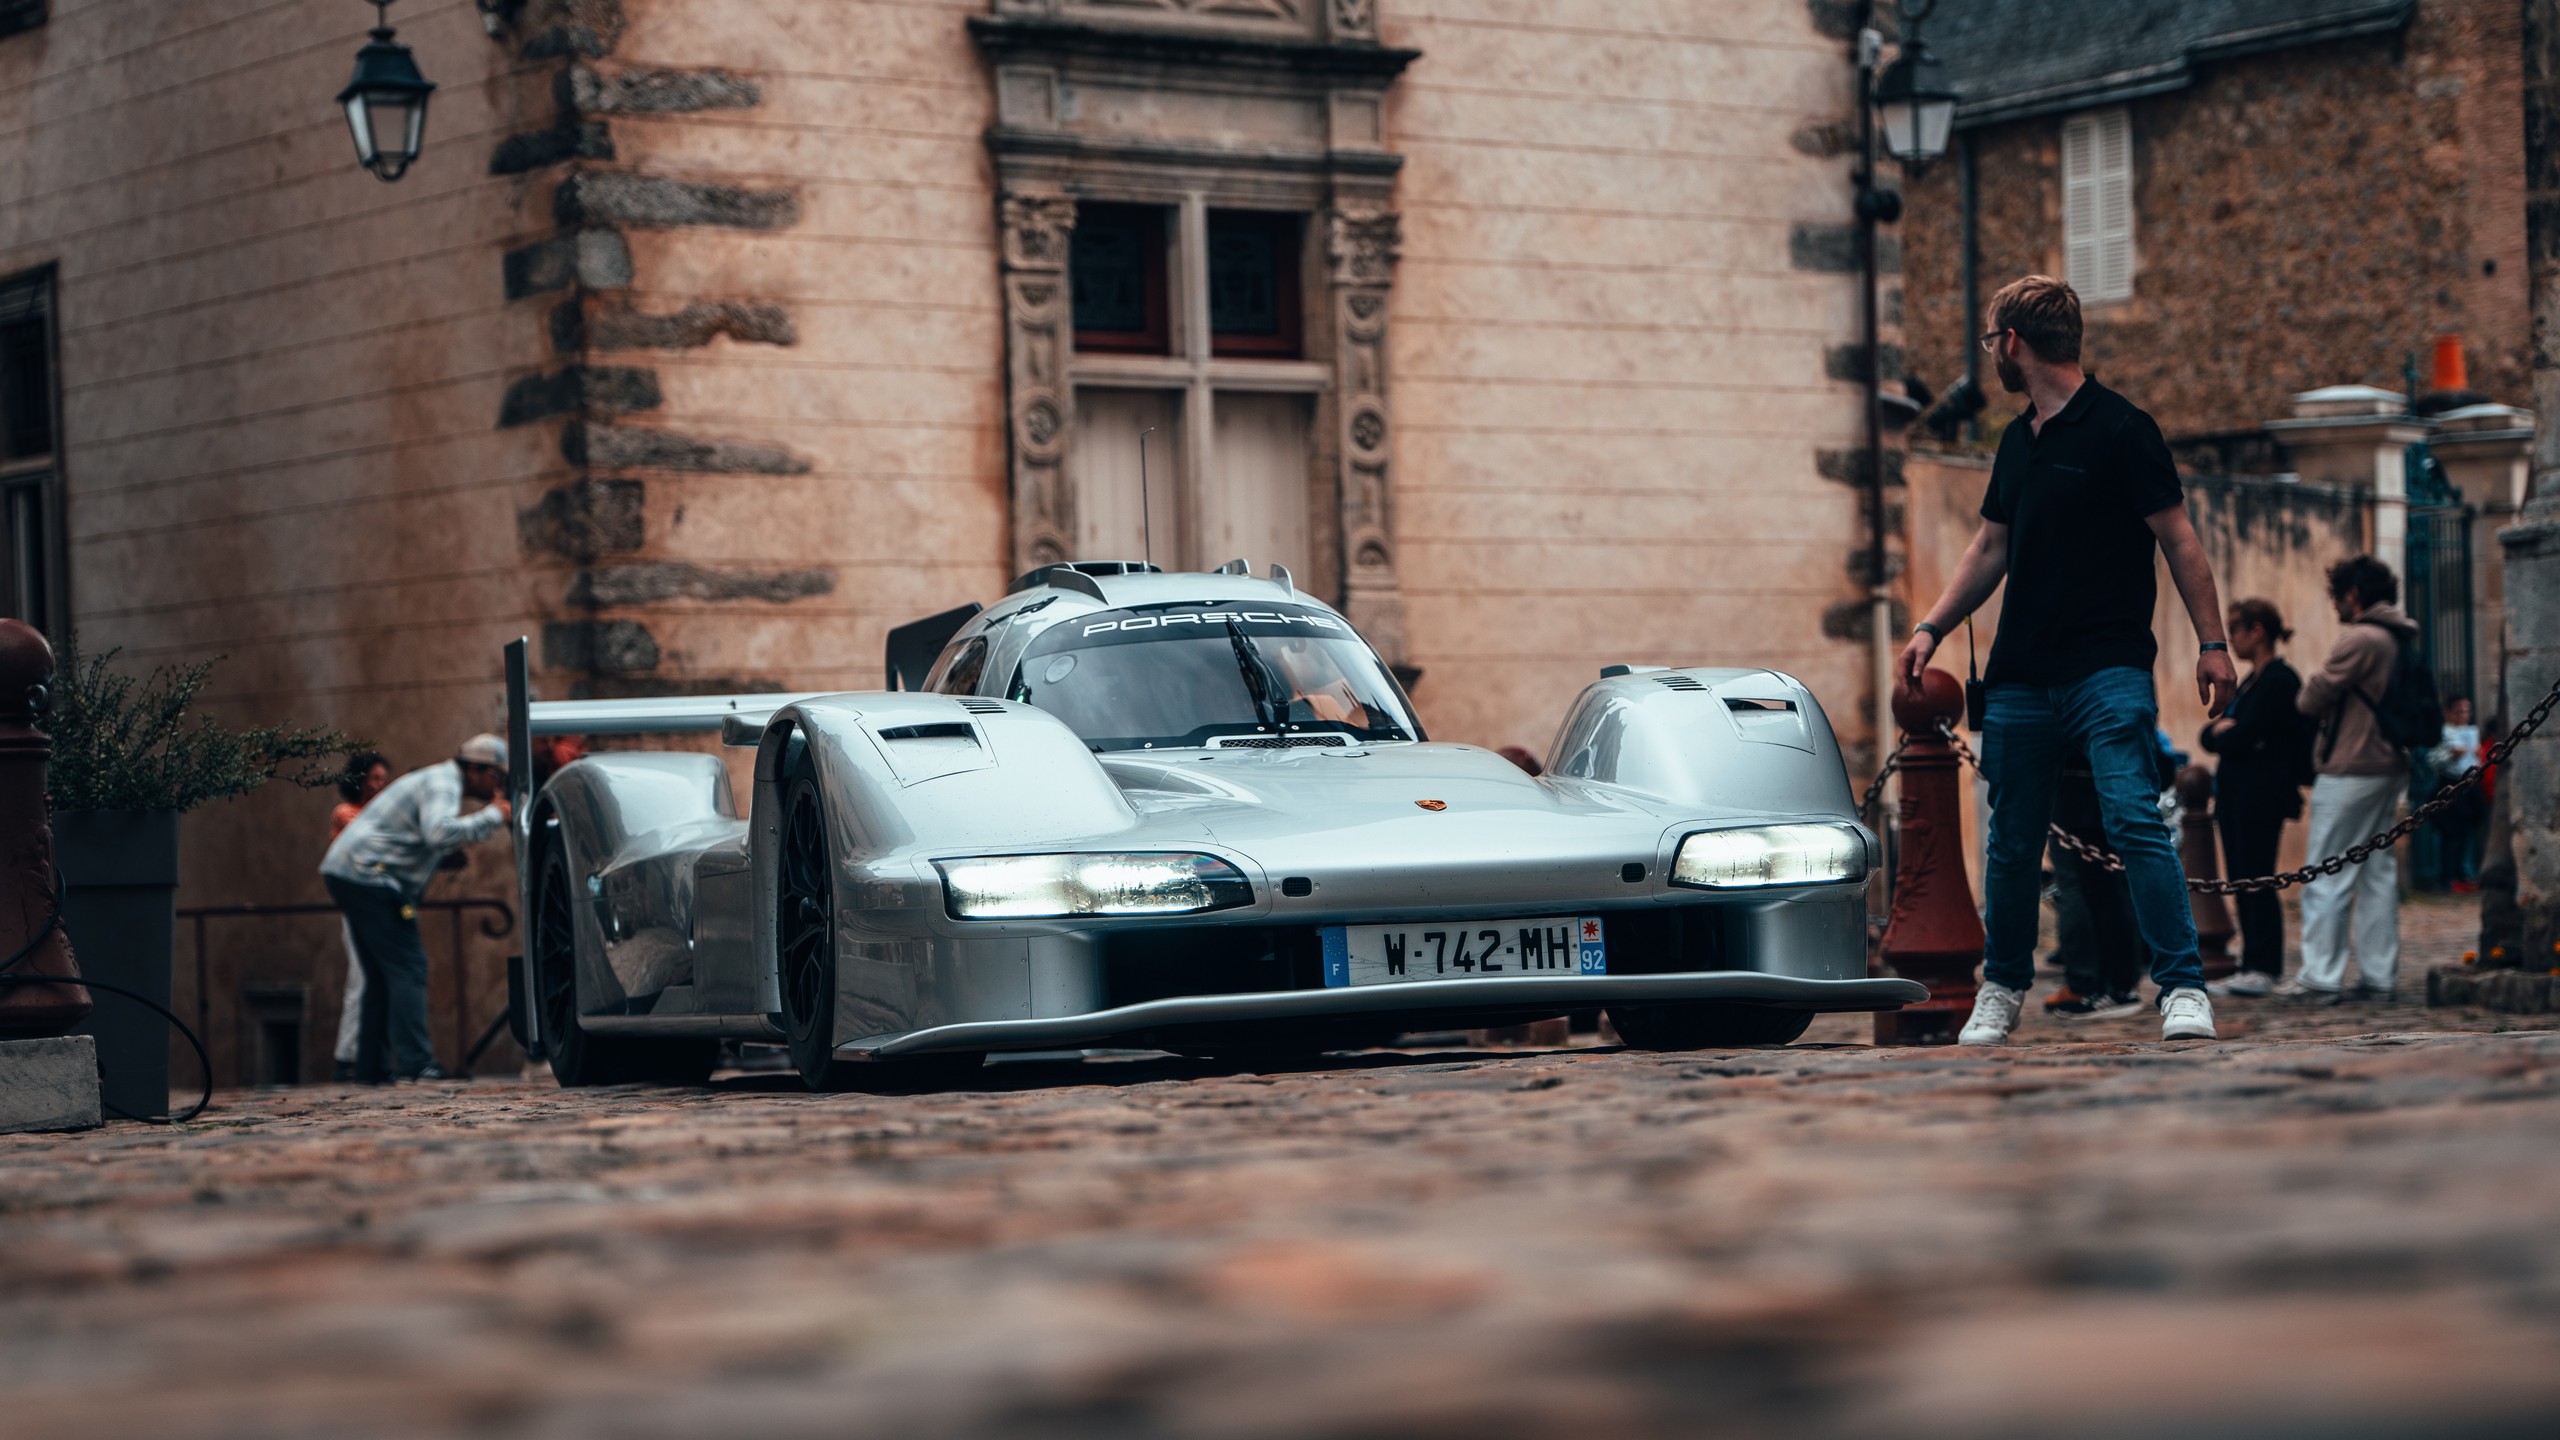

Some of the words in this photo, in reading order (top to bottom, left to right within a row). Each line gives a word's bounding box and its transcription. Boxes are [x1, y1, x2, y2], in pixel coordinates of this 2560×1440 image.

[1083, 612, 1342, 637] PORSCHE
[1332, 963, 1340, 976] F
[1582, 950, 1605, 970] 92
